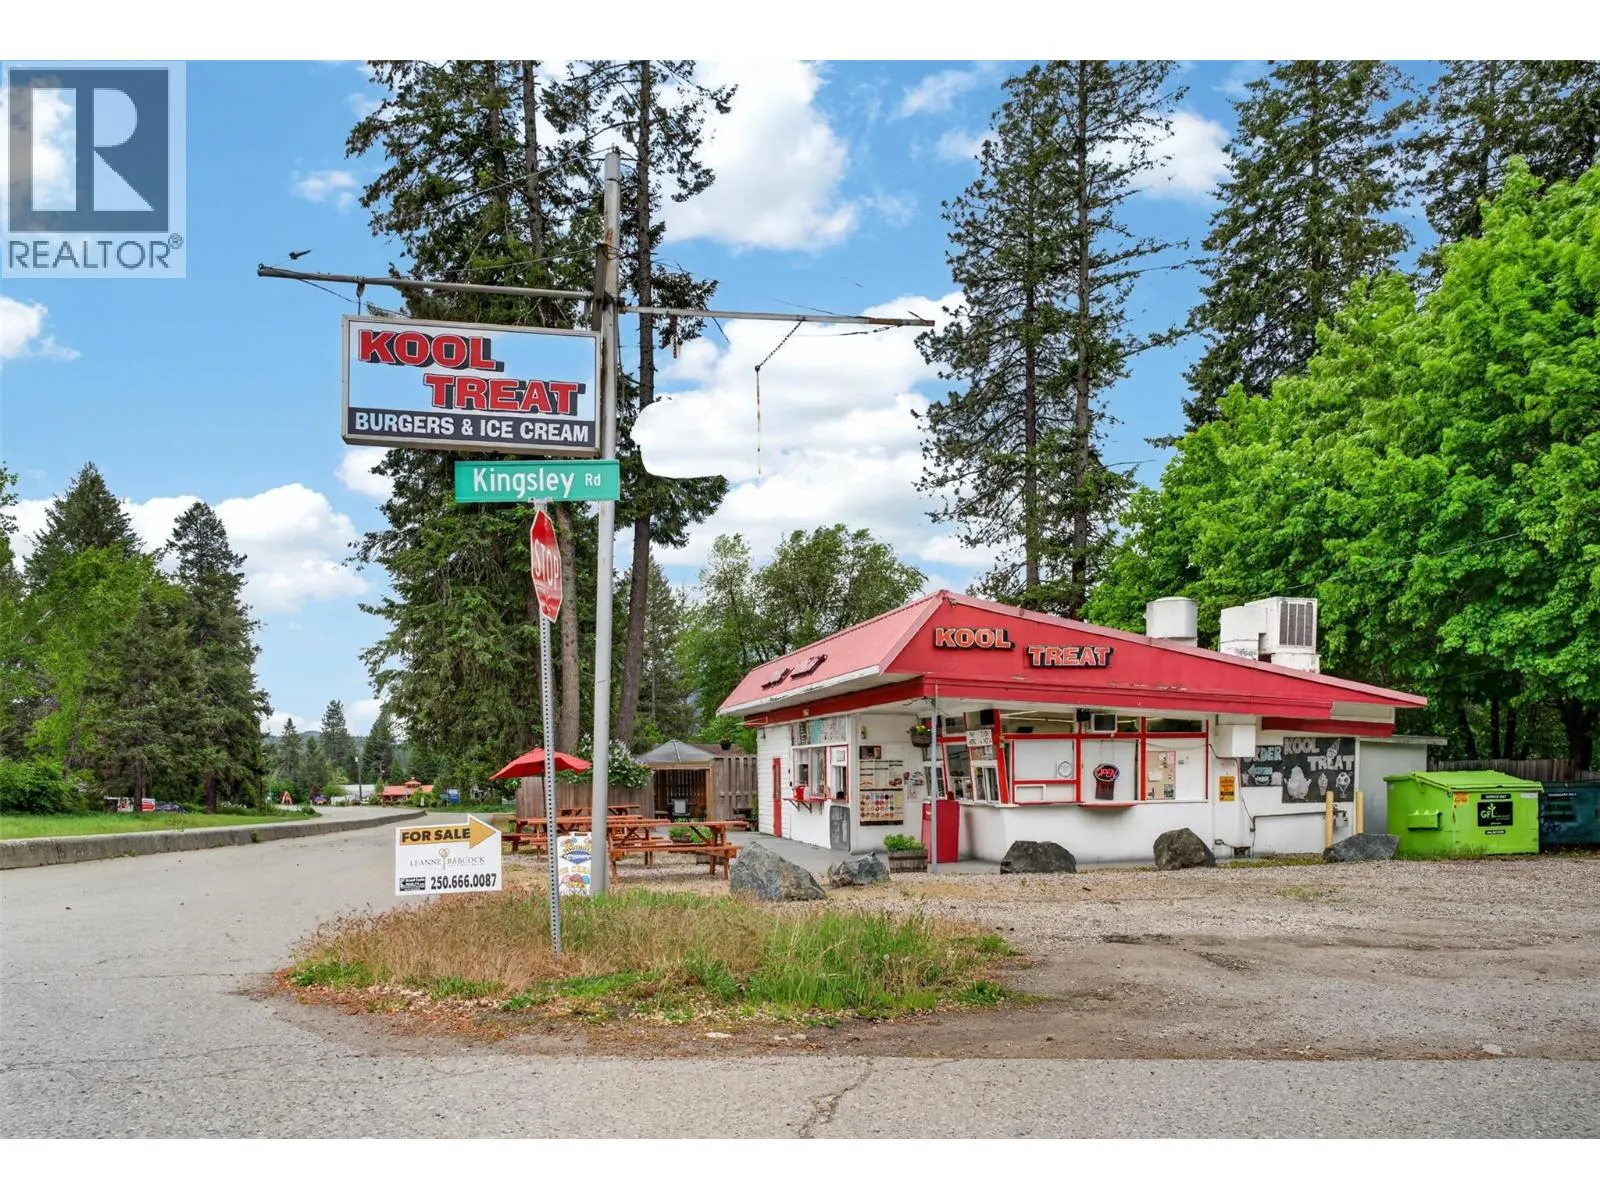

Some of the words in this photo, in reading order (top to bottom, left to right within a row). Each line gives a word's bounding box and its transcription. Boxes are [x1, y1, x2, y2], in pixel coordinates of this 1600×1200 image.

[358, 329, 503, 372] KOOL
[423, 373, 585, 415] TREAT
[354, 411, 455, 436] BURGERS
[461, 418, 474, 436] &
[480, 419, 514, 439] ICE
[519, 421, 589, 442] CREAM
[473, 467, 575, 498] Kingsley
[585, 472, 601, 487] Rd
[532, 538, 559, 592] STOP
[934, 627, 1013, 649] KOOL
[1028, 645, 1112, 668] TREAT
[1283, 738, 1321, 755] KOOL
[1307, 754, 1355, 772] TREAT
[401, 831, 431, 843] FOR
[434, 828, 471, 841] SALE
[447, 856, 485, 865] BABCOCK
[430, 873, 497, 890] 250.666.0087
